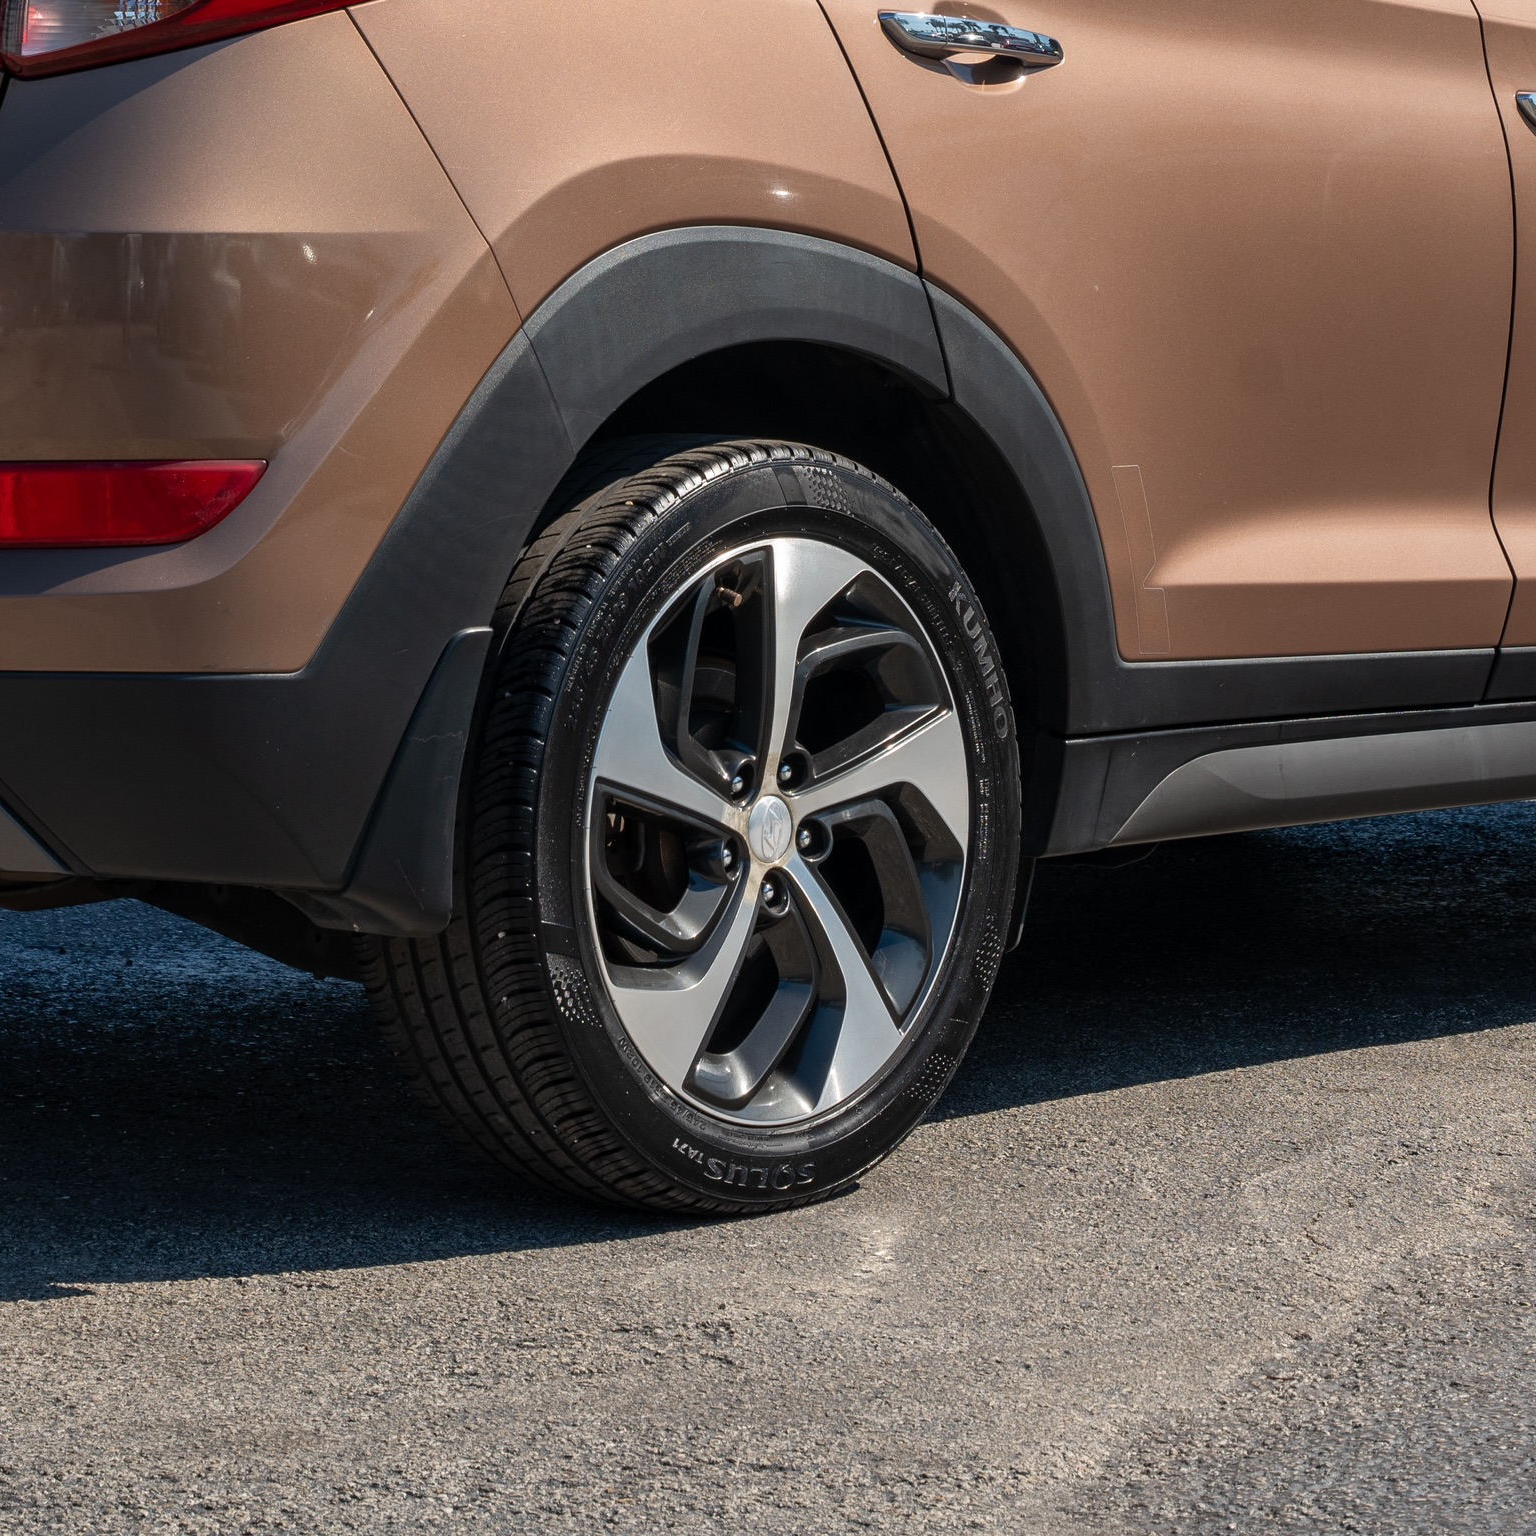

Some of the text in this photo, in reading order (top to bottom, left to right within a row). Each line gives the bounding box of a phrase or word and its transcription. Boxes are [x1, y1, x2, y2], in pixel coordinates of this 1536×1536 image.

[948, 580, 1010, 739] KUMHO
[671, 1136, 704, 1165] TA71
[703, 1158, 816, 1190] SOLUS
